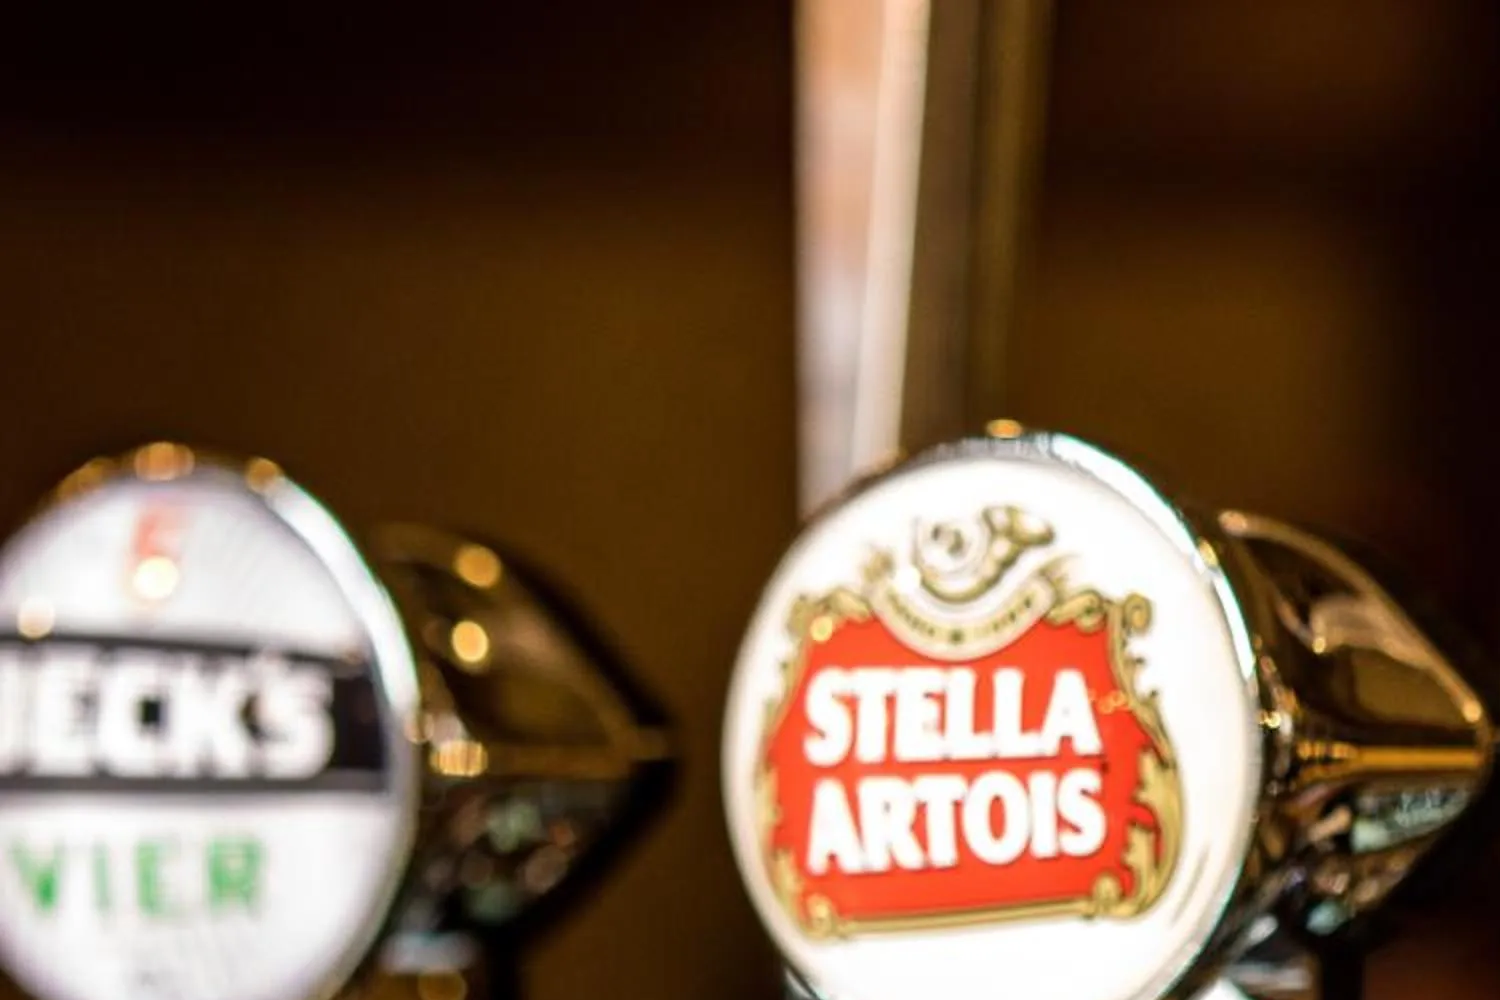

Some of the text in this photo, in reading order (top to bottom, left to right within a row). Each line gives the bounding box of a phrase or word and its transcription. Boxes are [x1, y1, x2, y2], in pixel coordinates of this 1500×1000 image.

[804, 667, 1102, 765] STELLA
[807, 769, 1107, 875] ARTOIS
[10, 835, 268, 916] VIER
